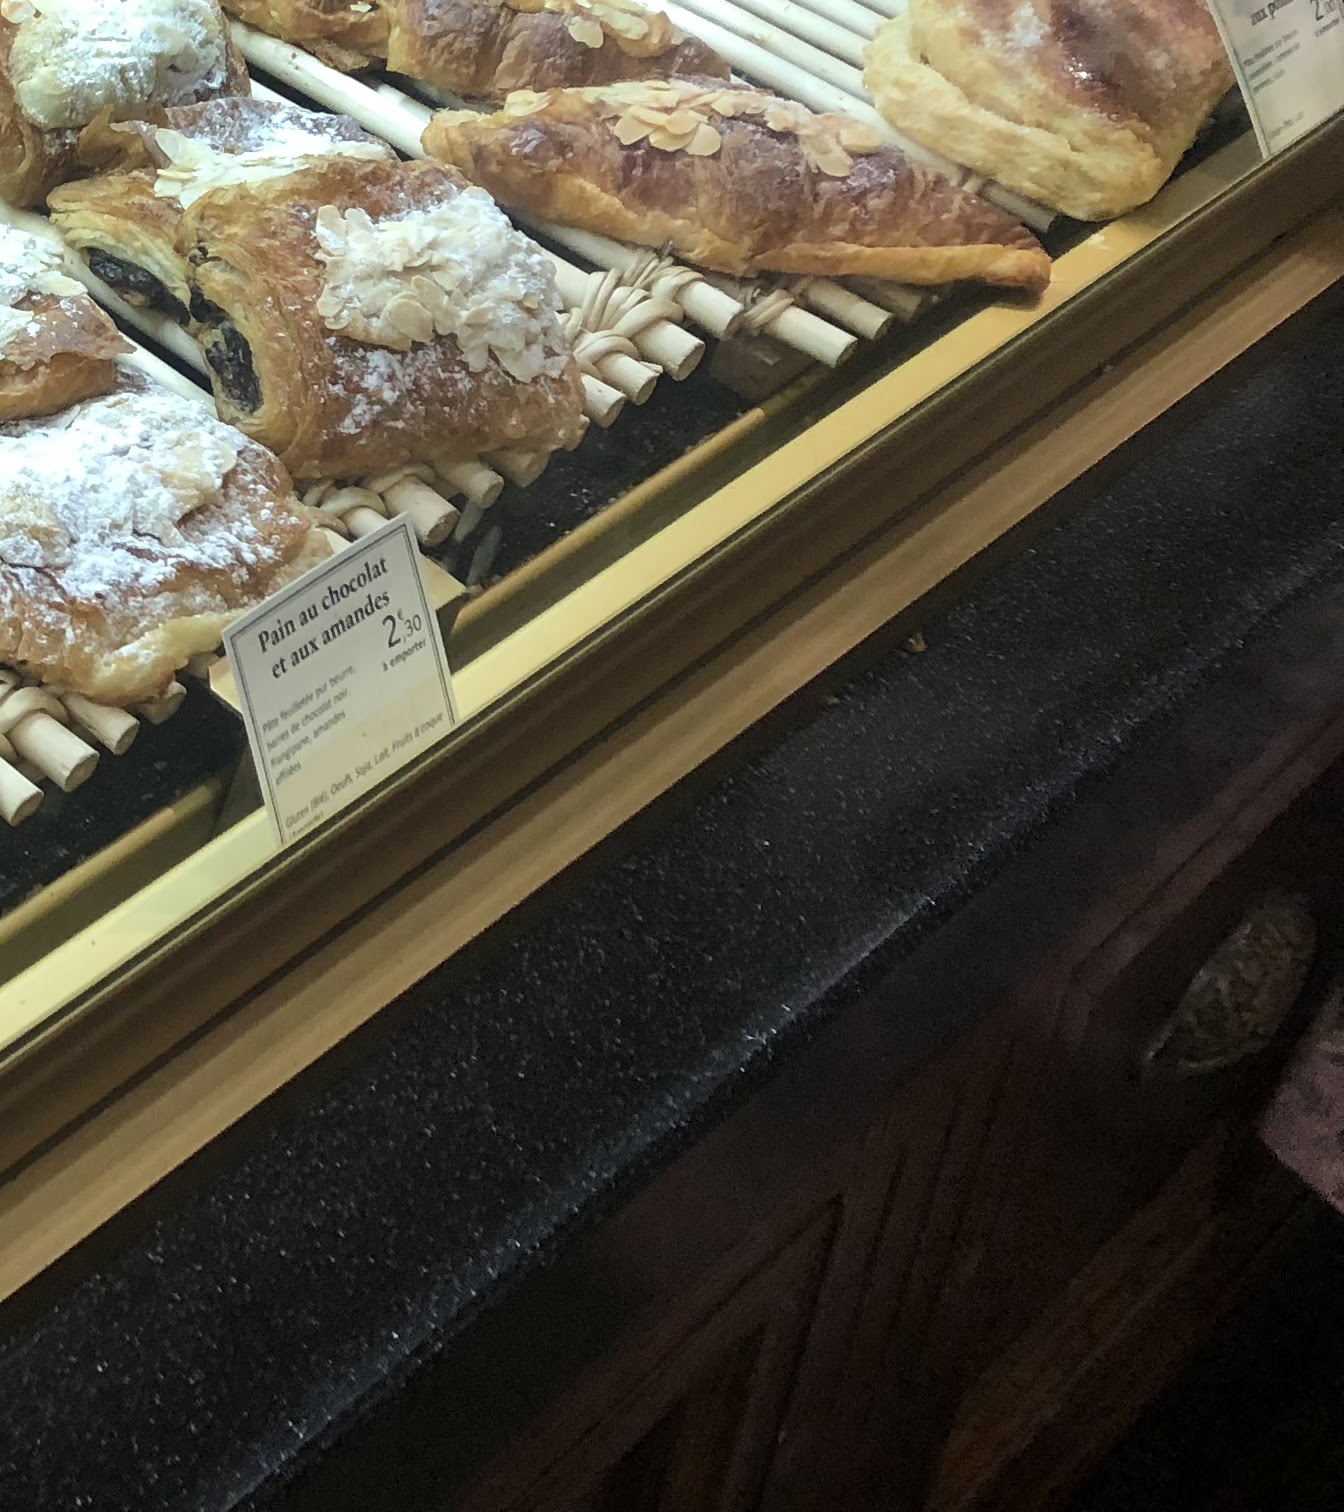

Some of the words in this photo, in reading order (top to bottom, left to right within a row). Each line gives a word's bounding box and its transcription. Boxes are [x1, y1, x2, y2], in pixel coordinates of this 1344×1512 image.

[257, 618, 296, 653] Pain
[299, 602, 320, 627] au
[321, 557, 389, 612] chocolat
[272, 657, 288, 679] et
[291, 638, 320, 670] aux
[322, 590, 391, 646] amandes
[389, 637, 427, 668] emporter
